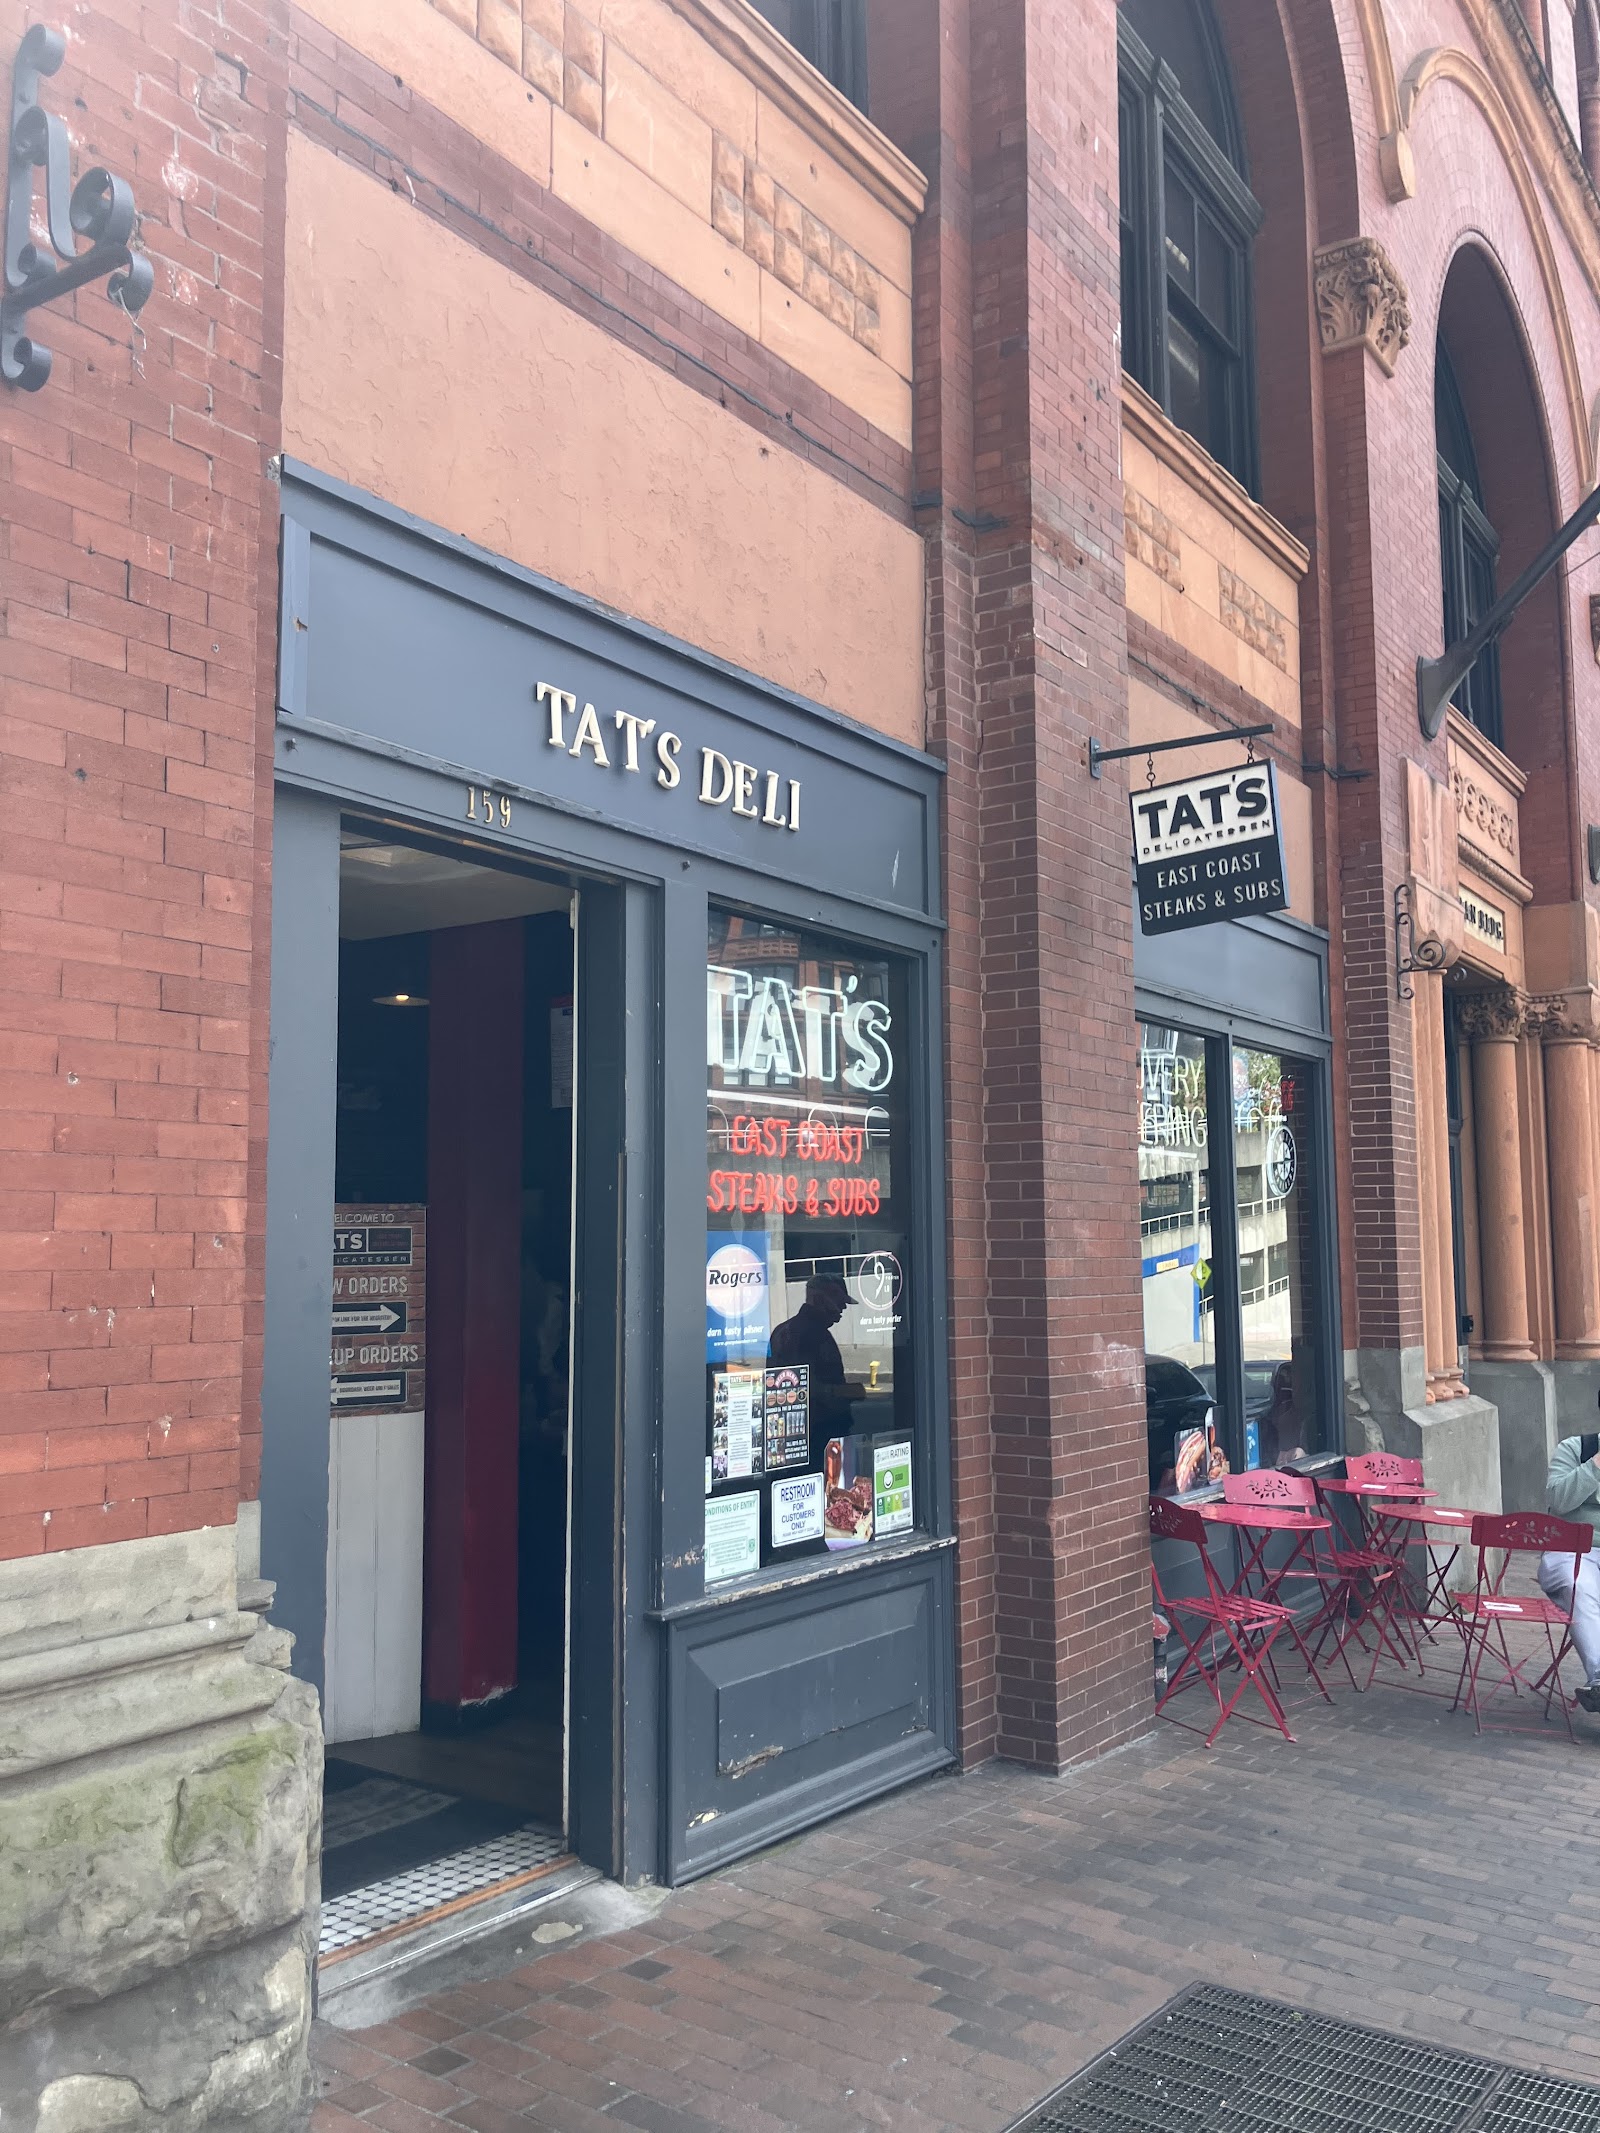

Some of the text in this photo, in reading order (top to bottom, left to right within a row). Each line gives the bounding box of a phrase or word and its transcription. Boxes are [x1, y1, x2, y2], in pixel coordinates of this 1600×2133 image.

[536, 681, 801, 832] TAT'S DELI
[466, 786, 513, 829] 159
[1138, 774, 1268, 840] TAT'S
[1143, 819, 1271, 855] DELICATESSEN
[1157, 852, 1262, 889] EAST COAST
[1143, 878, 1282, 921] STEAKS & SUBS
[707, 964, 893, 1091] TAT'S
[732, 1115, 864, 1164] EAST COAST
[707, 1170, 880, 1216] STEAKS & SUBS
[381, 1213, 395, 1223] TO
[348, 1276, 409, 1296] ORDERS
[330, 1344, 419, 1366] UP ORDERS
[890, 1446, 909, 1459] RATING
[733, 1502, 739, 1511] OF
[741, 1499, 756, 1510] ENTRY
[780, 1482, 815, 1502] RESTROOM
[792, 1502, 804, 1511] FOR
[782, 1509, 815, 1524] CUSTOMERS
[791, 1516, 806, 1529] ONLY
